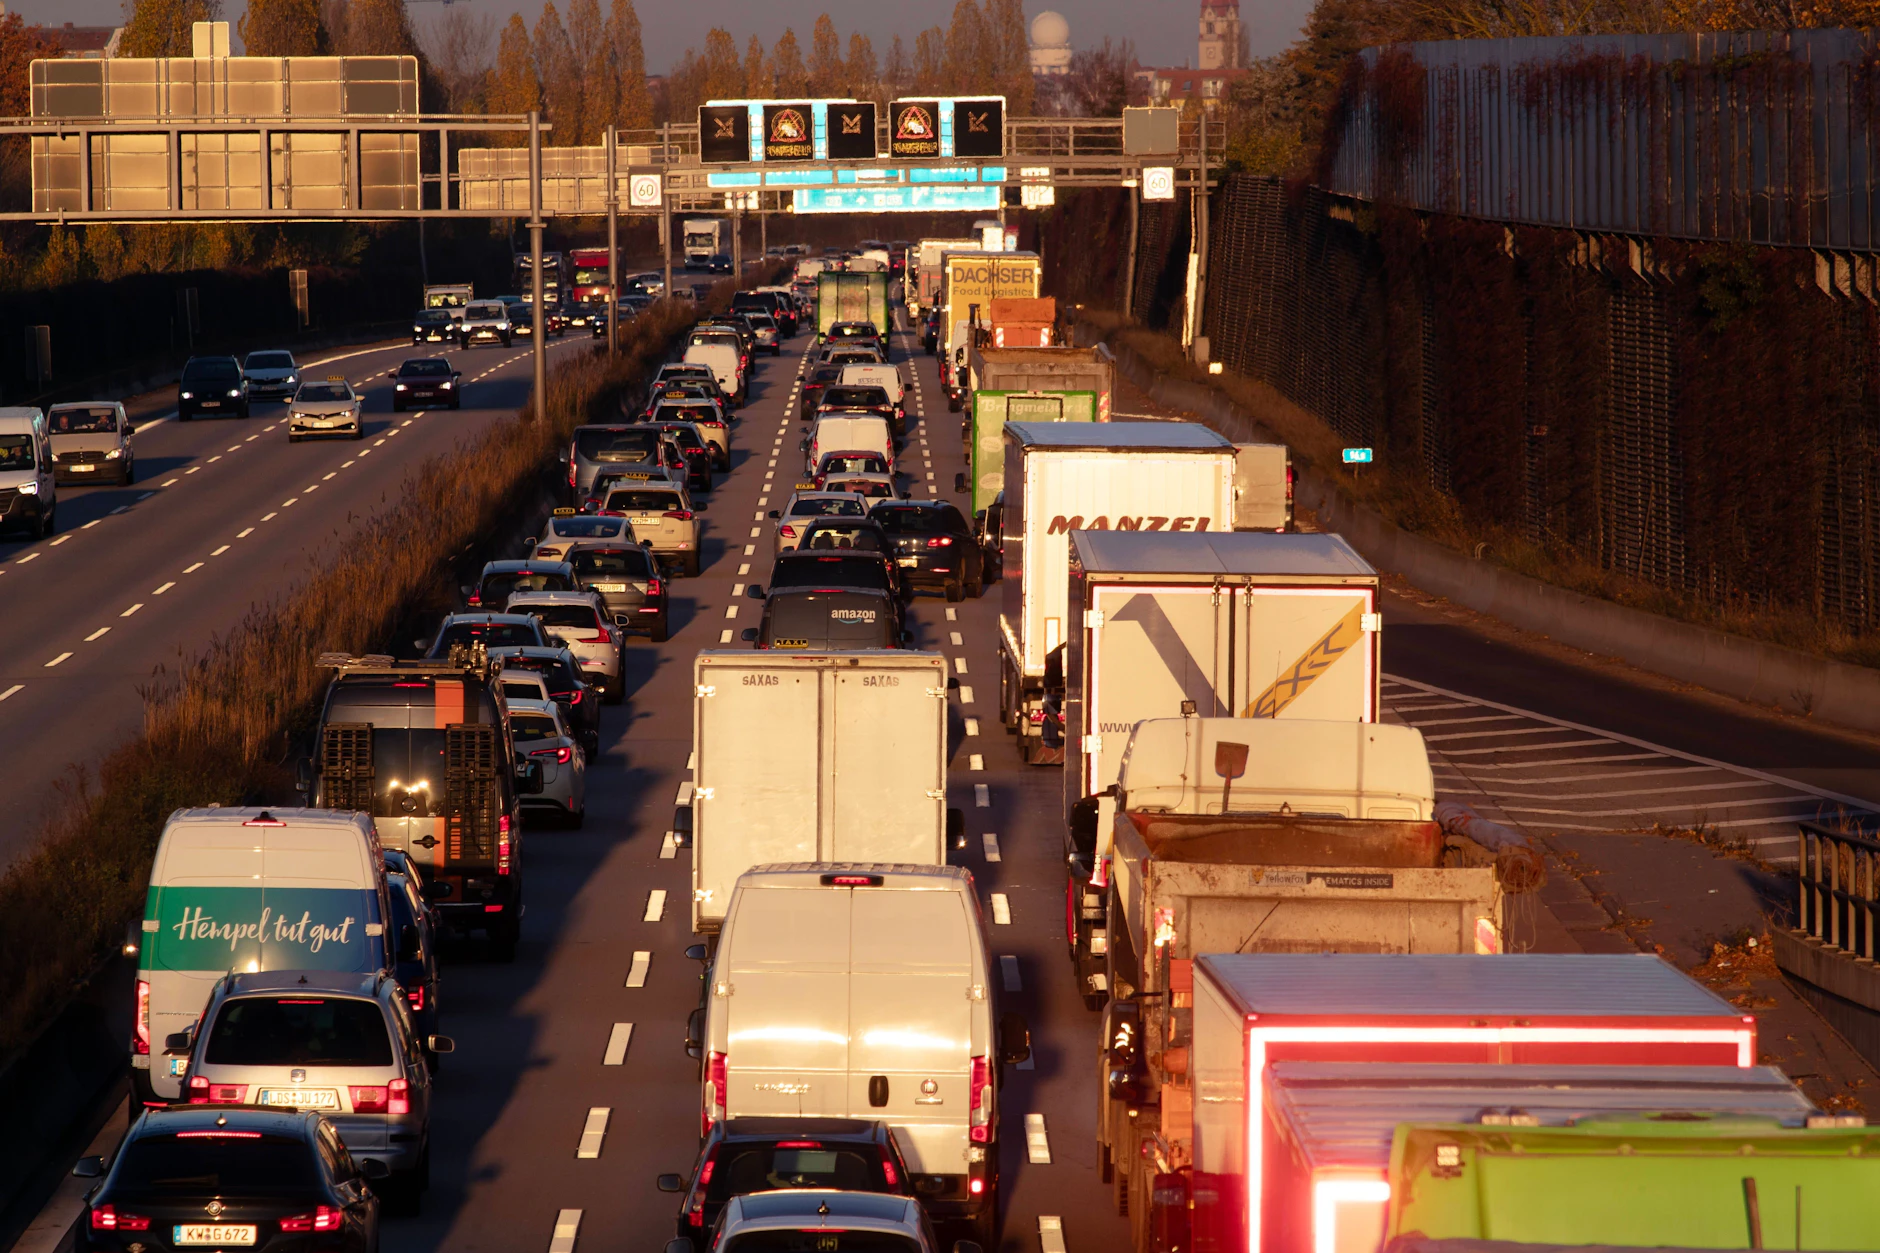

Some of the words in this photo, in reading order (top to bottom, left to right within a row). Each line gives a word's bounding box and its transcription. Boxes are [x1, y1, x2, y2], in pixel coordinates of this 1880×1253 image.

[1150, 177, 1166, 189] 60
[638, 184, 654, 197] 60
[952, 267, 1034, 284] DACHSER
[952, 286, 981, 296] Food
[984, 286, 1034, 298] Logistics
[830, 608, 876, 620] amazon
[742, 674, 779, 686] SAXAS
[863, 675, 900, 688] SAXAS
[1264, 873, 1305, 884] YellowFox
[1364, 877, 1390, 887] INSIDE
[172, 906, 272, 952] Hempel
[273, 910, 311, 943] tut
[310, 915, 352, 953] gut
[269, 1091, 290, 1105] LDS
[298, 1091, 312, 1105] JU
[314, 1091, 334, 1105] 177
[186, 1227, 203, 1241] KW
[213, 1227, 221, 1241] G
[224, 1227, 249, 1241] 672
